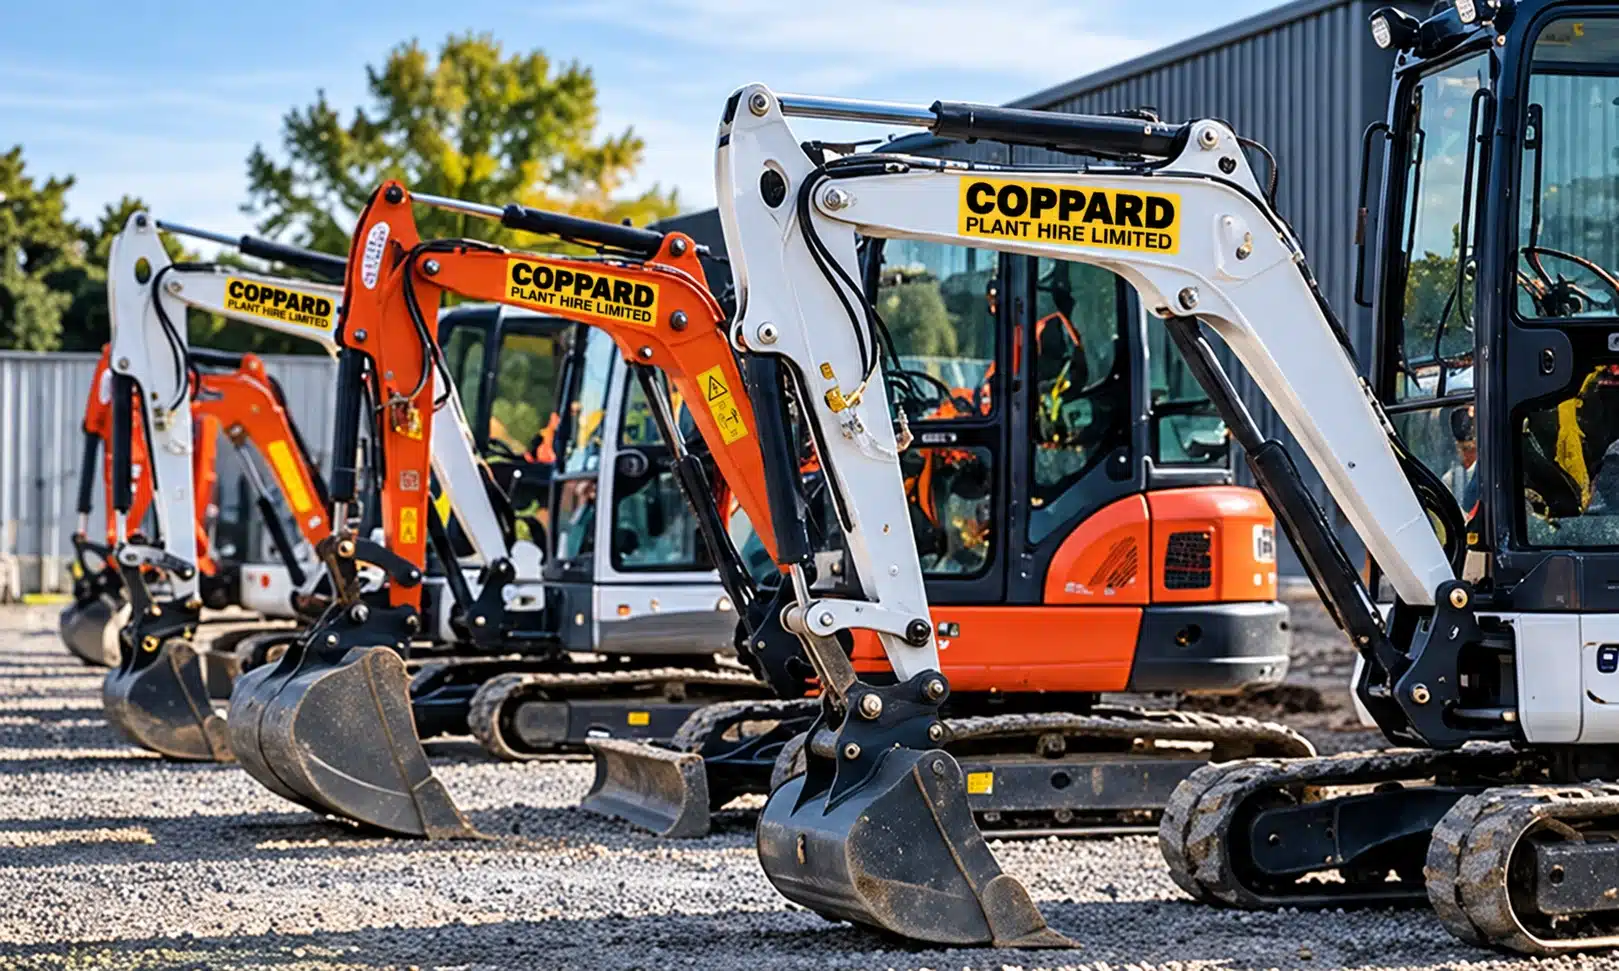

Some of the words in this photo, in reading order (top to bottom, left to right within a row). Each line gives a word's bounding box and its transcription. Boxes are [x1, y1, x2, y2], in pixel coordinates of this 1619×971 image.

[966, 182, 1175, 229] COPPARD
[966, 217, 1031, 237] PLANT
[1038, 223, 1085, 241] HIRE
[1092, 228, 1172, 249] LIMITED
[229, 281, 331, 317] COPPARD
[512, 262, 654, 308] COPPARD
[228, 299, 260, 313] PLANT
[262, 306, 286, 319] HIRE
[289, 312, 328, 328] LIMITED
[511, 286, 556, 304] PLANT
[560, 295, 592, 311] HIRE
[597, 303, 651, 322] LIMITED
